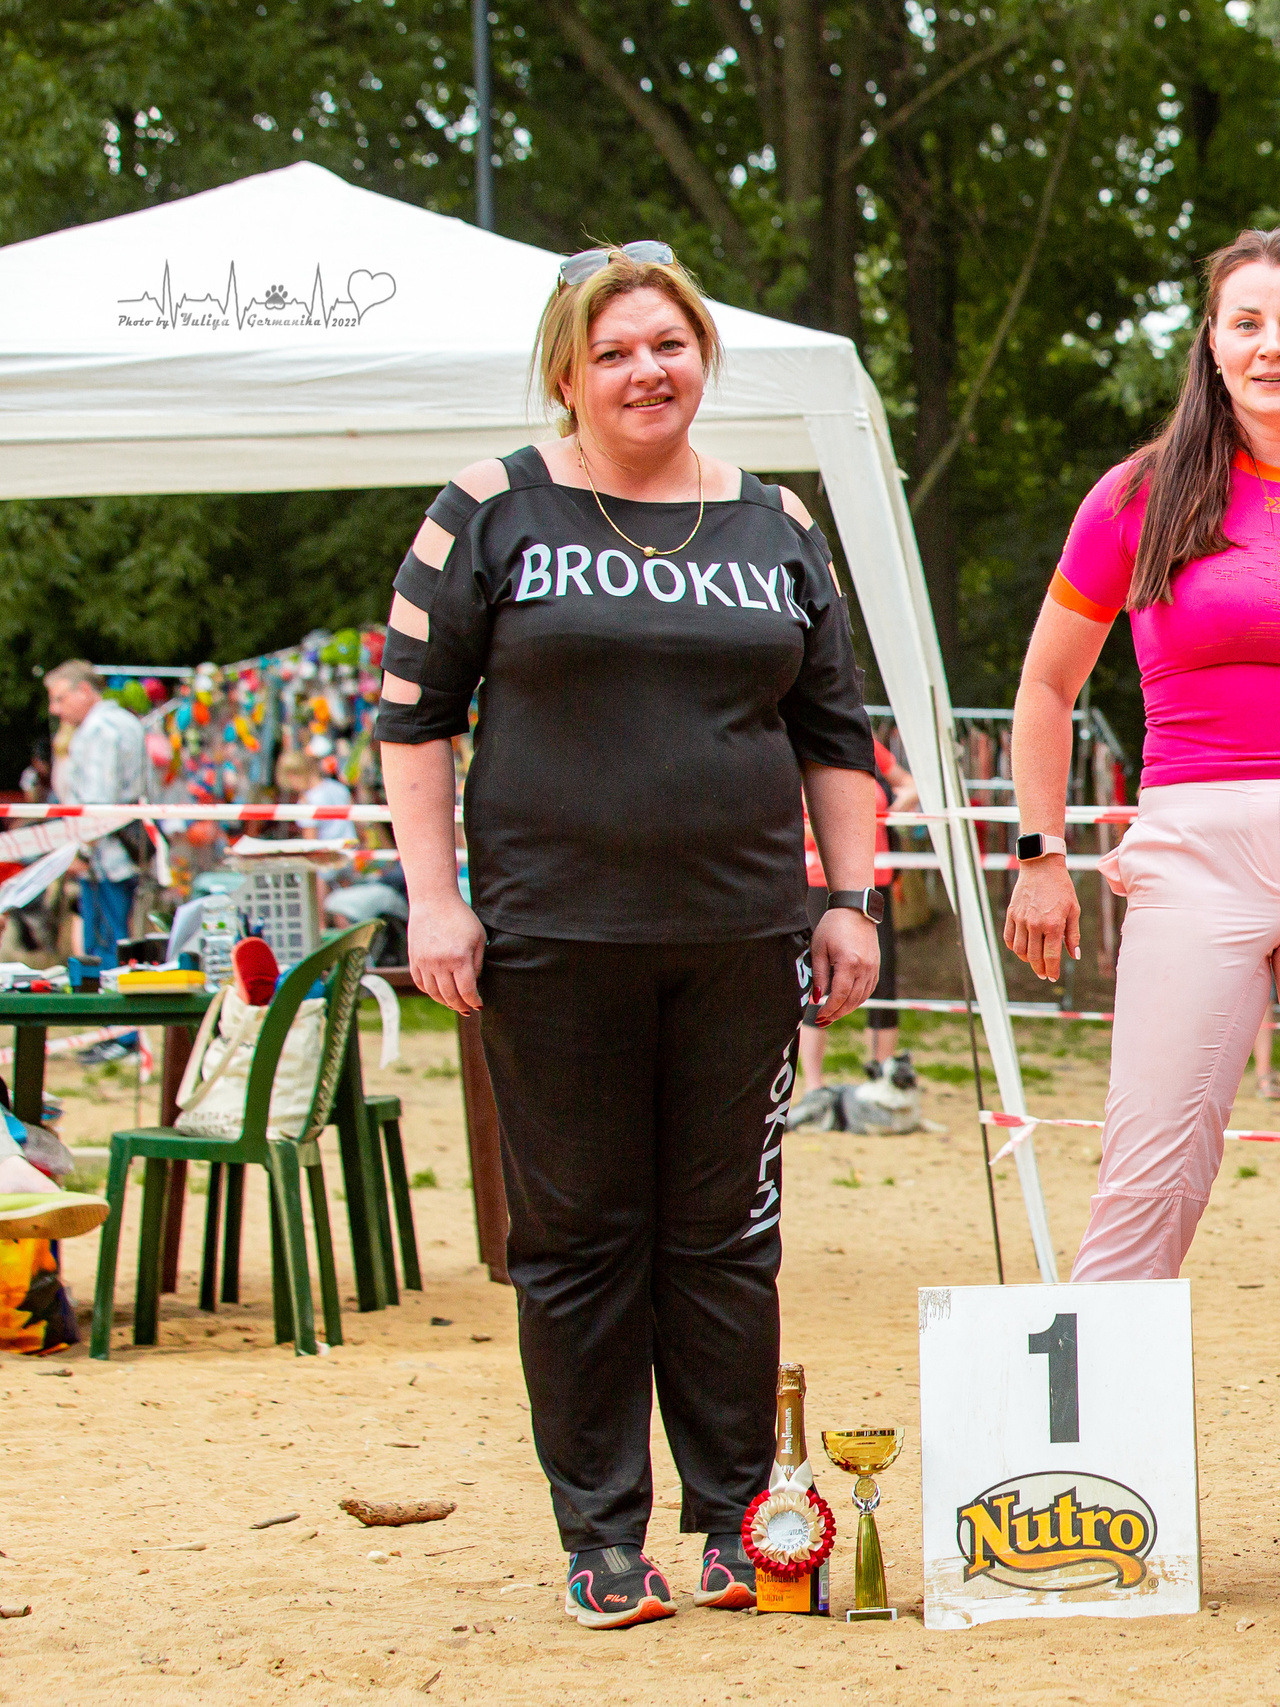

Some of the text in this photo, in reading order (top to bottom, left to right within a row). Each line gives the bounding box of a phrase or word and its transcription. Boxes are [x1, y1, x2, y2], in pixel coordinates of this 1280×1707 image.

[1028, 1312, 1080, 1443] 1
[958, 1487, 1149, 1583] Nutro
[603, 1594, 628, 1603] FILA
